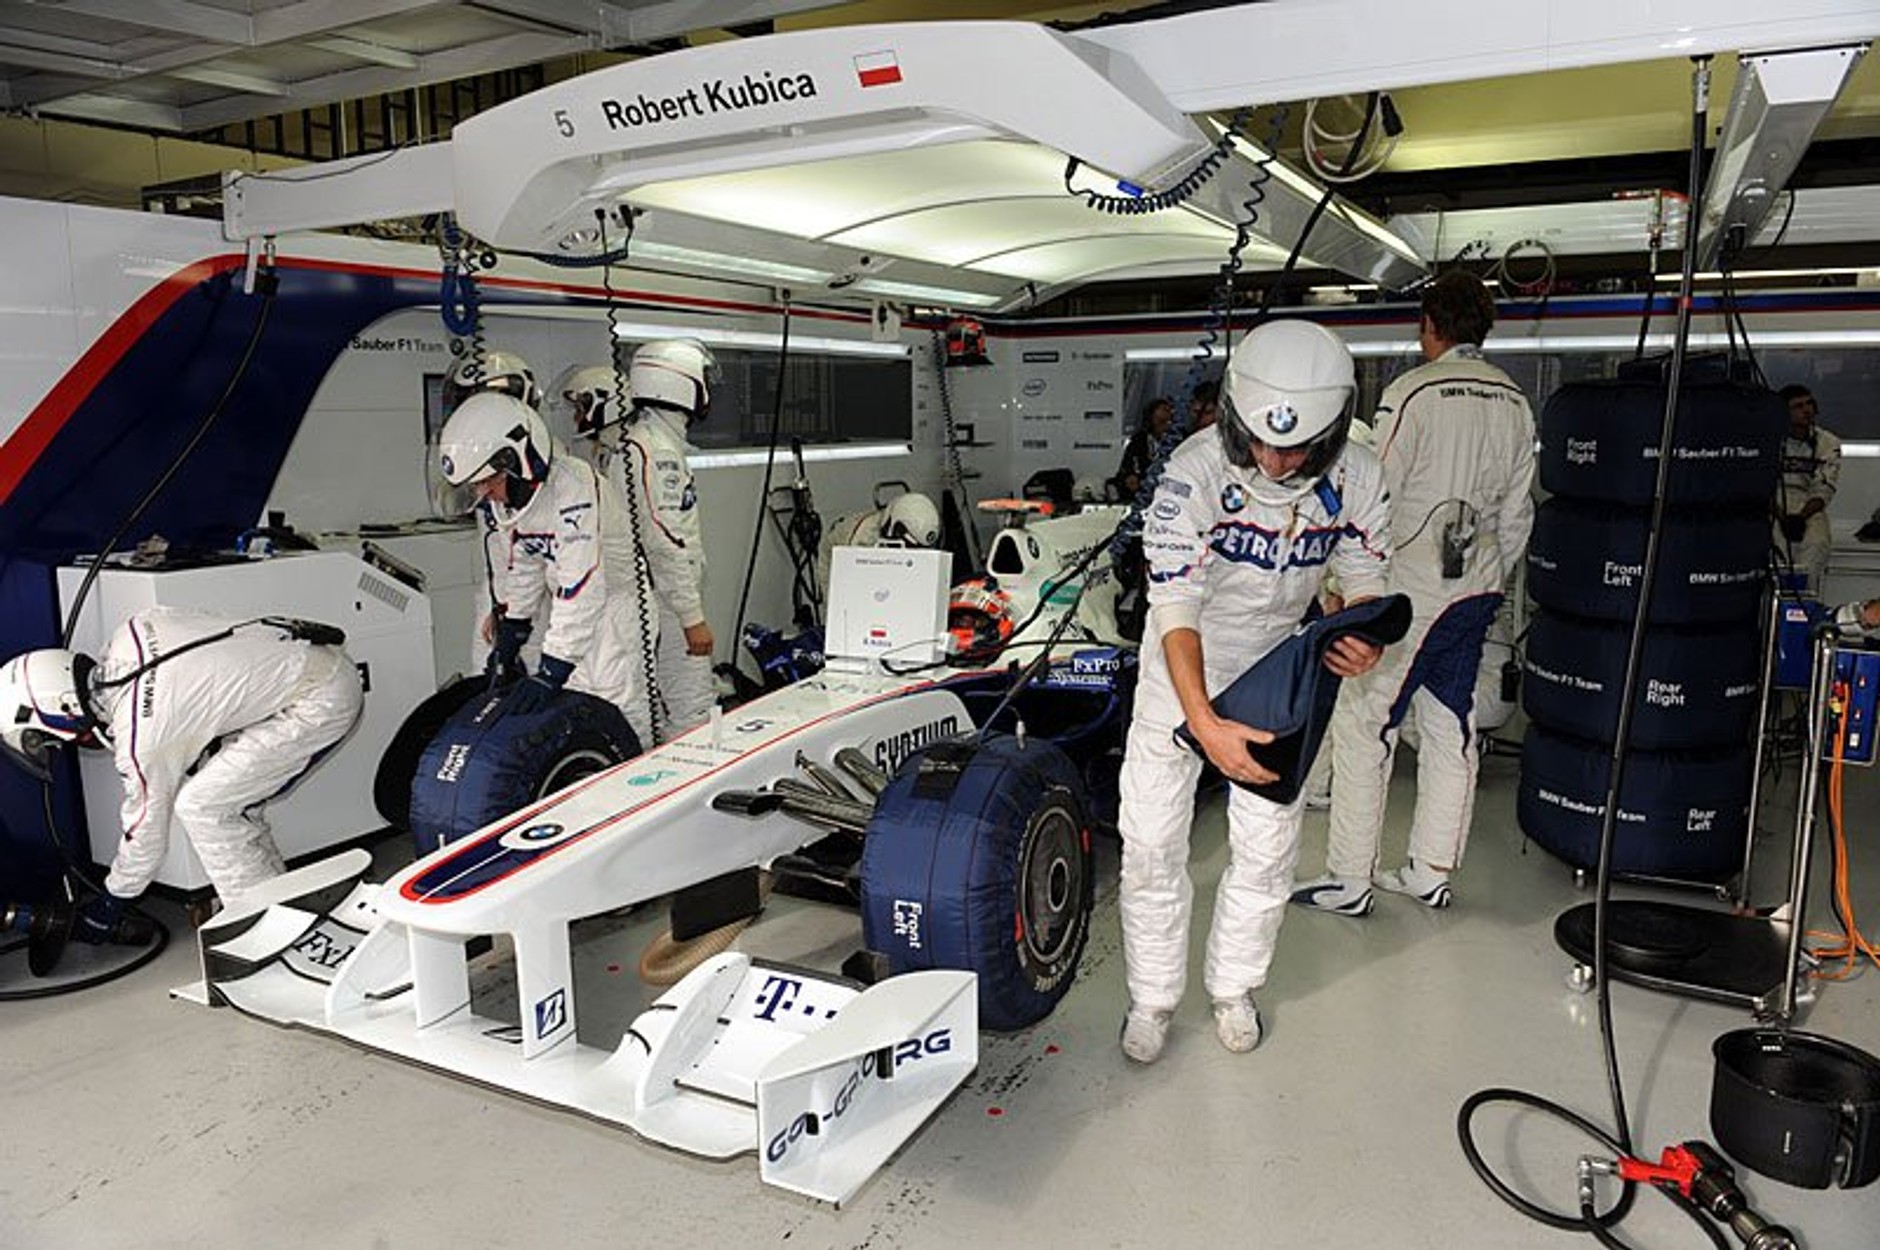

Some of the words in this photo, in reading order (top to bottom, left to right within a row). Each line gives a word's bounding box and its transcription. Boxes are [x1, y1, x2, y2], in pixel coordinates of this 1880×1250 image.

[554, 110, 575, 138] 5
[601, 88, 704, 130] Robert
[703, 71, 817, 113] Kubica
[1568, 437, 1597, 451] Front
[1568, 451, 1597, 464] Right
[1722, 446, 1735, 457] F1
[1604, 561, 1642, 576] Front
[1603, 573, 1632, 587] Left
[1689, 573, 1719, 584] BMW
[1648, 679, 1682, 692] Rear
[1647, 690, 1685, 707] Right
[1689, 808, 1717, 820] Rear
[1687, 819, 1711, 831] Left
[894, 900, 908, 934] Left
[909, 902, 922, 948] Front
